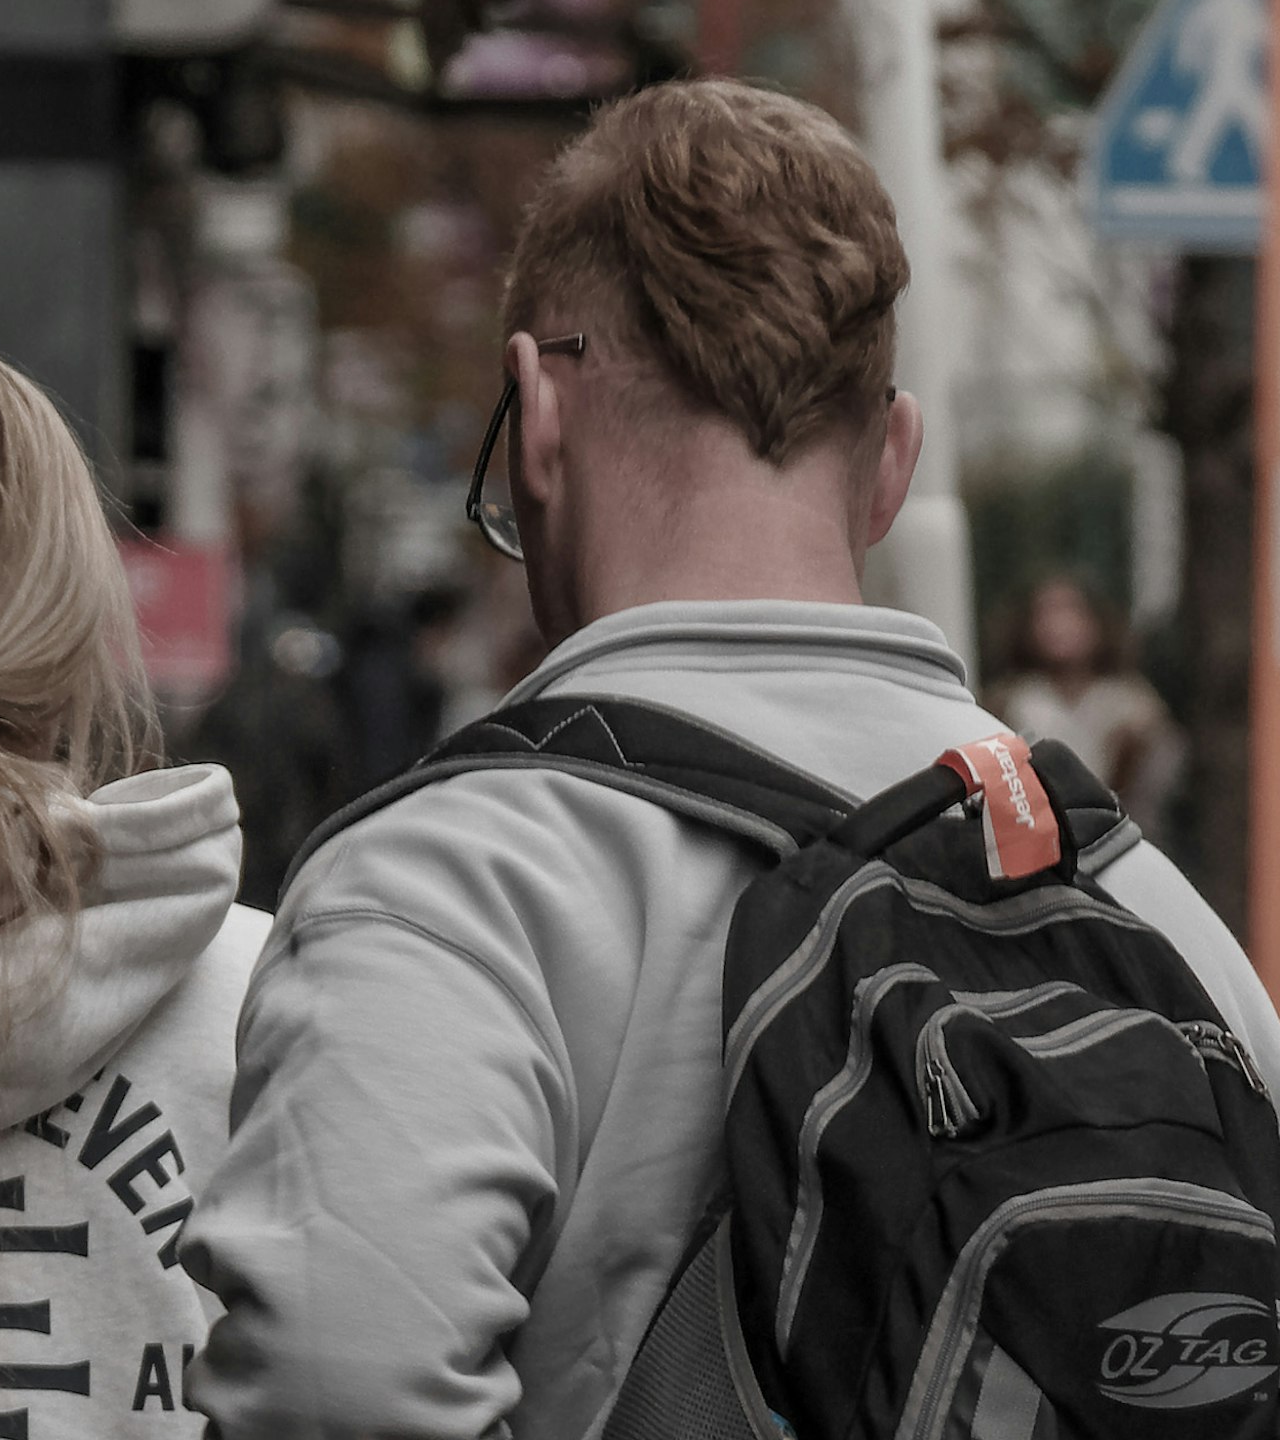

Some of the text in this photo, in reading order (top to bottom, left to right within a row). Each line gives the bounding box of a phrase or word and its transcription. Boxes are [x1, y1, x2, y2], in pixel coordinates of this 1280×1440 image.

[998, 748, 1036, 830] Jetstar
[132, 1343, 194, 1411] A
[1101, 1334, 1164, 1380] OZ
[1179, 1338, 1268, 1365] TAG
